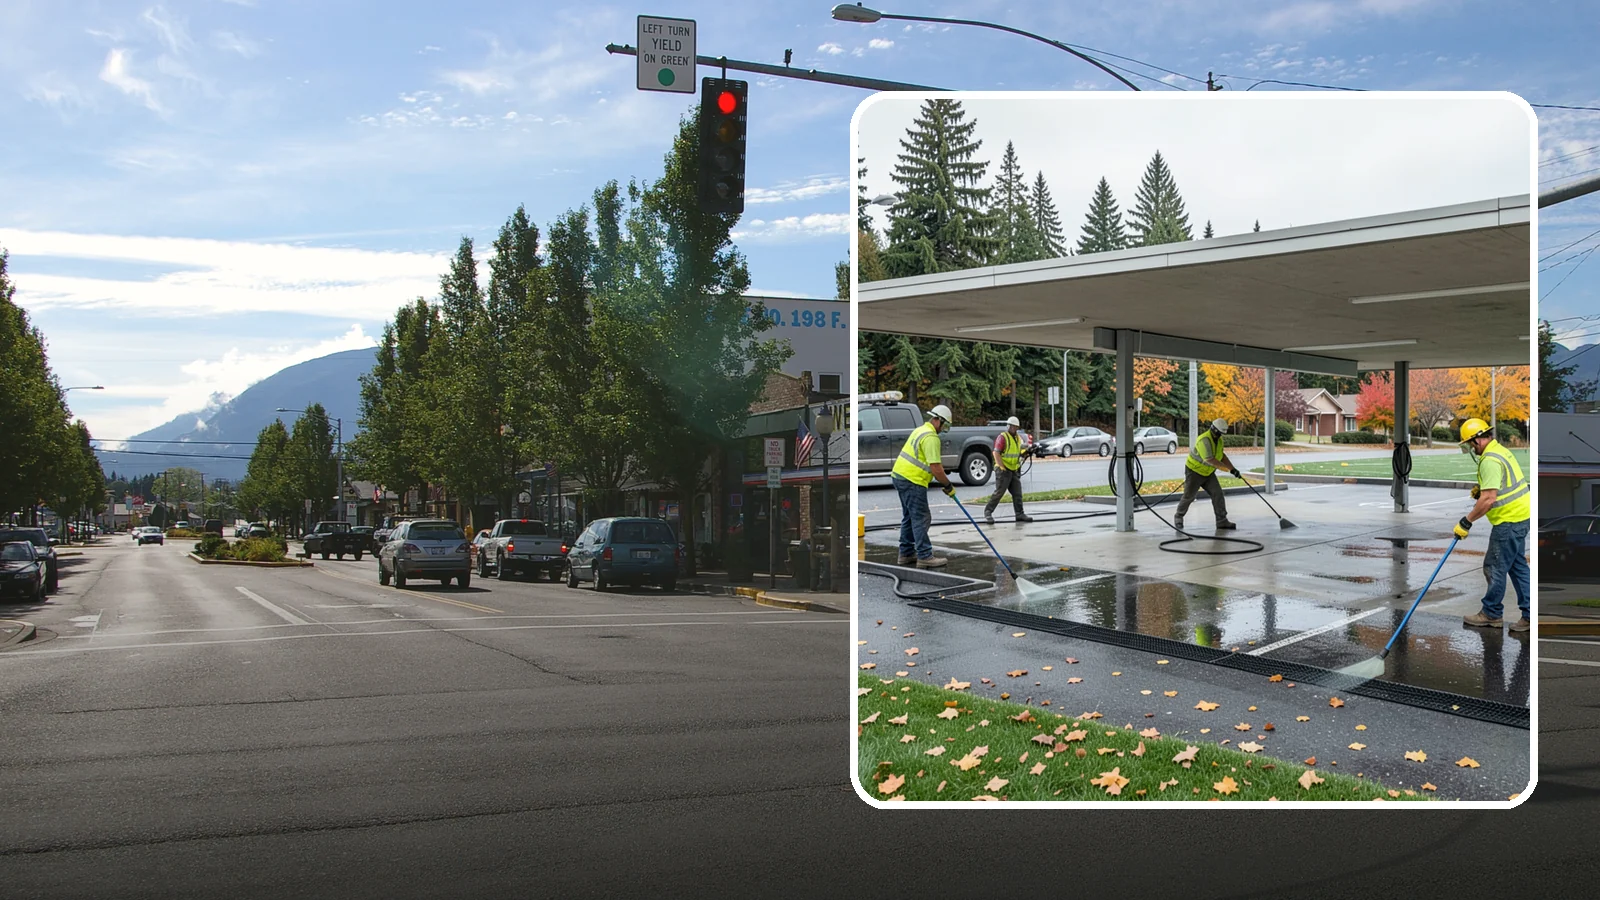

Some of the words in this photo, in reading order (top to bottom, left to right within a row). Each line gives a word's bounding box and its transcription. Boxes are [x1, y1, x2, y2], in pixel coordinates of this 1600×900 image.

[643, 23, 663, 34] LEFT
[668, 25, 690, 37] TURN
[652, 38, 682, 52] YIELD
[644, 53, 656, 64] ON
[661, 54, 689, 66] GREEN
[791, 309, 826, 328] 198
[831, 311, 847, 329] F.
